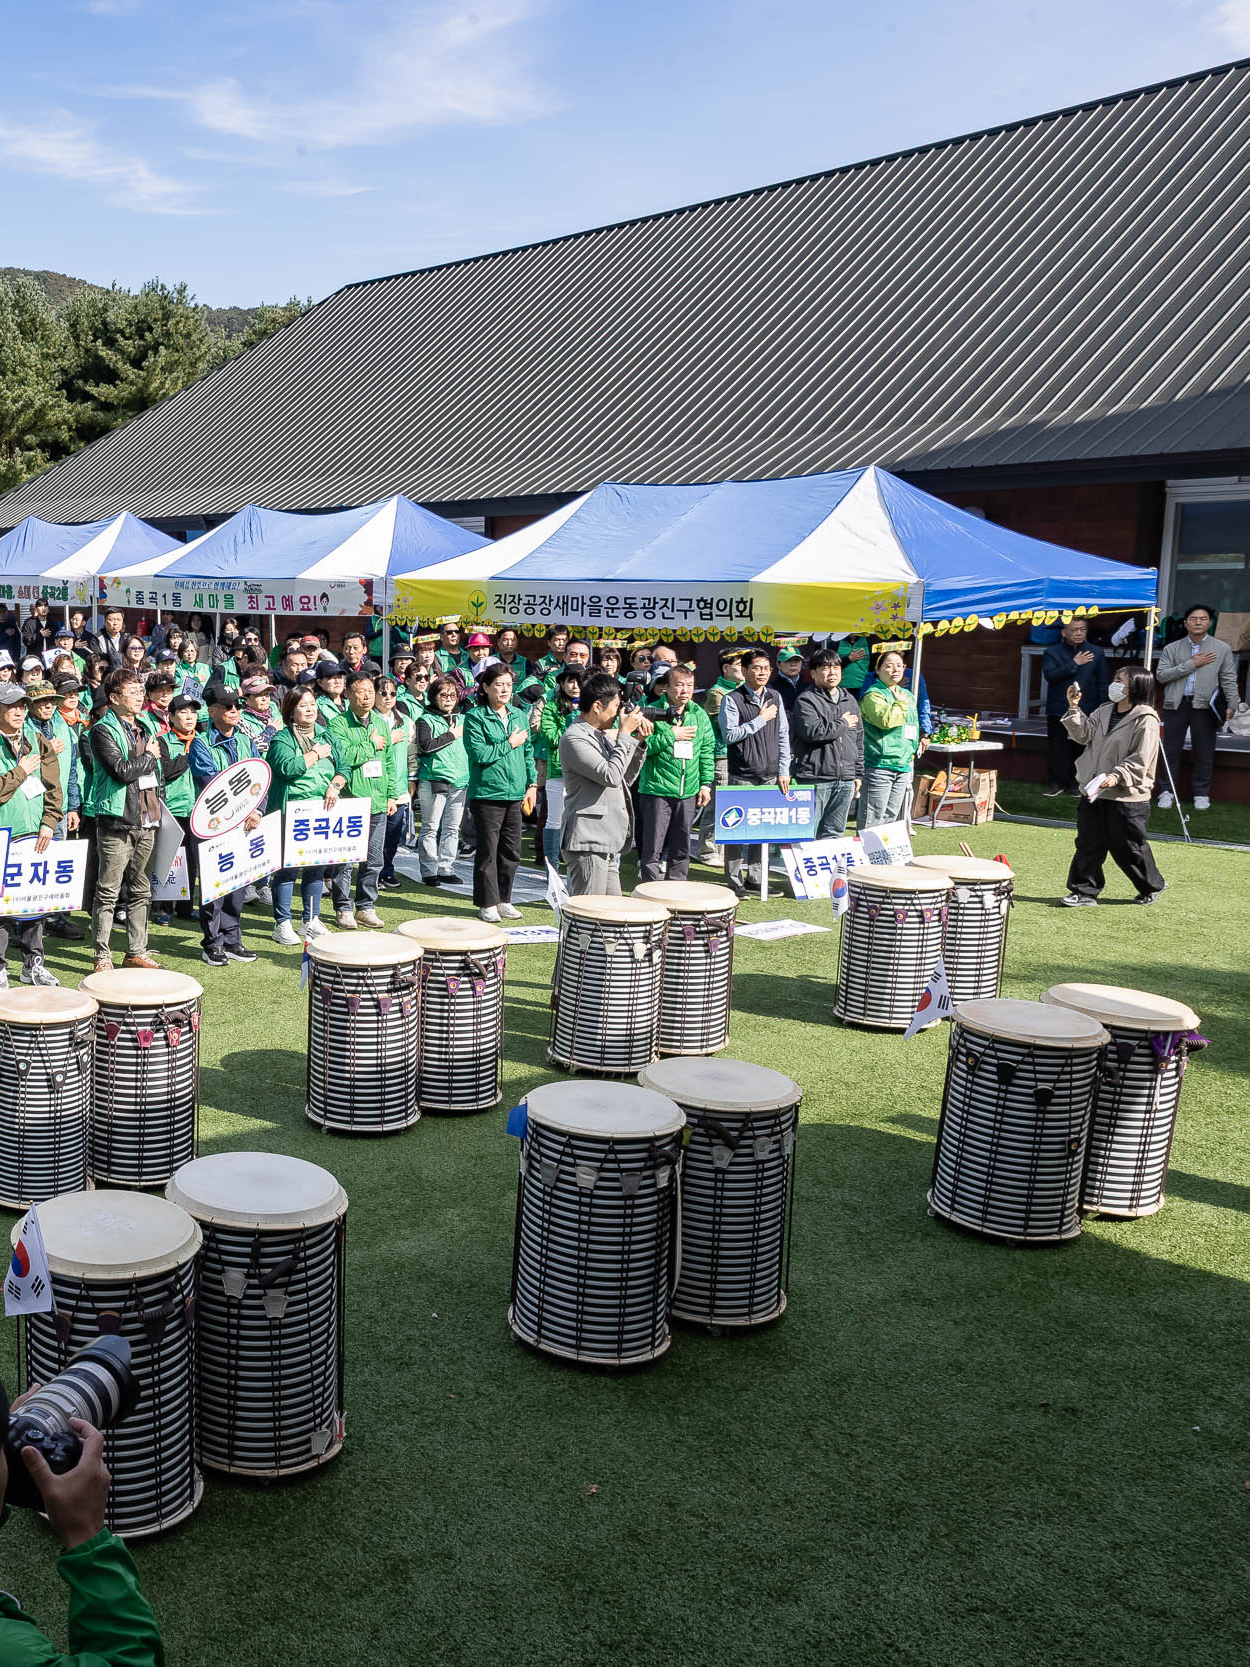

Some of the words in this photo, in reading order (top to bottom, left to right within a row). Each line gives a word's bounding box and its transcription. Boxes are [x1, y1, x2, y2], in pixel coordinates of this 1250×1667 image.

[135, 590, 182, 608] 중곡1동
[193, 593, 235, 610] 새마을
[247, 594, 318, 612] 최고예요!
[493, 593, 755, 622] 직장공장새마을운동광진구협의회
[293, 815, 363, 842] 중곡4동
[747, 807, 811, 826] 중곡제1동
